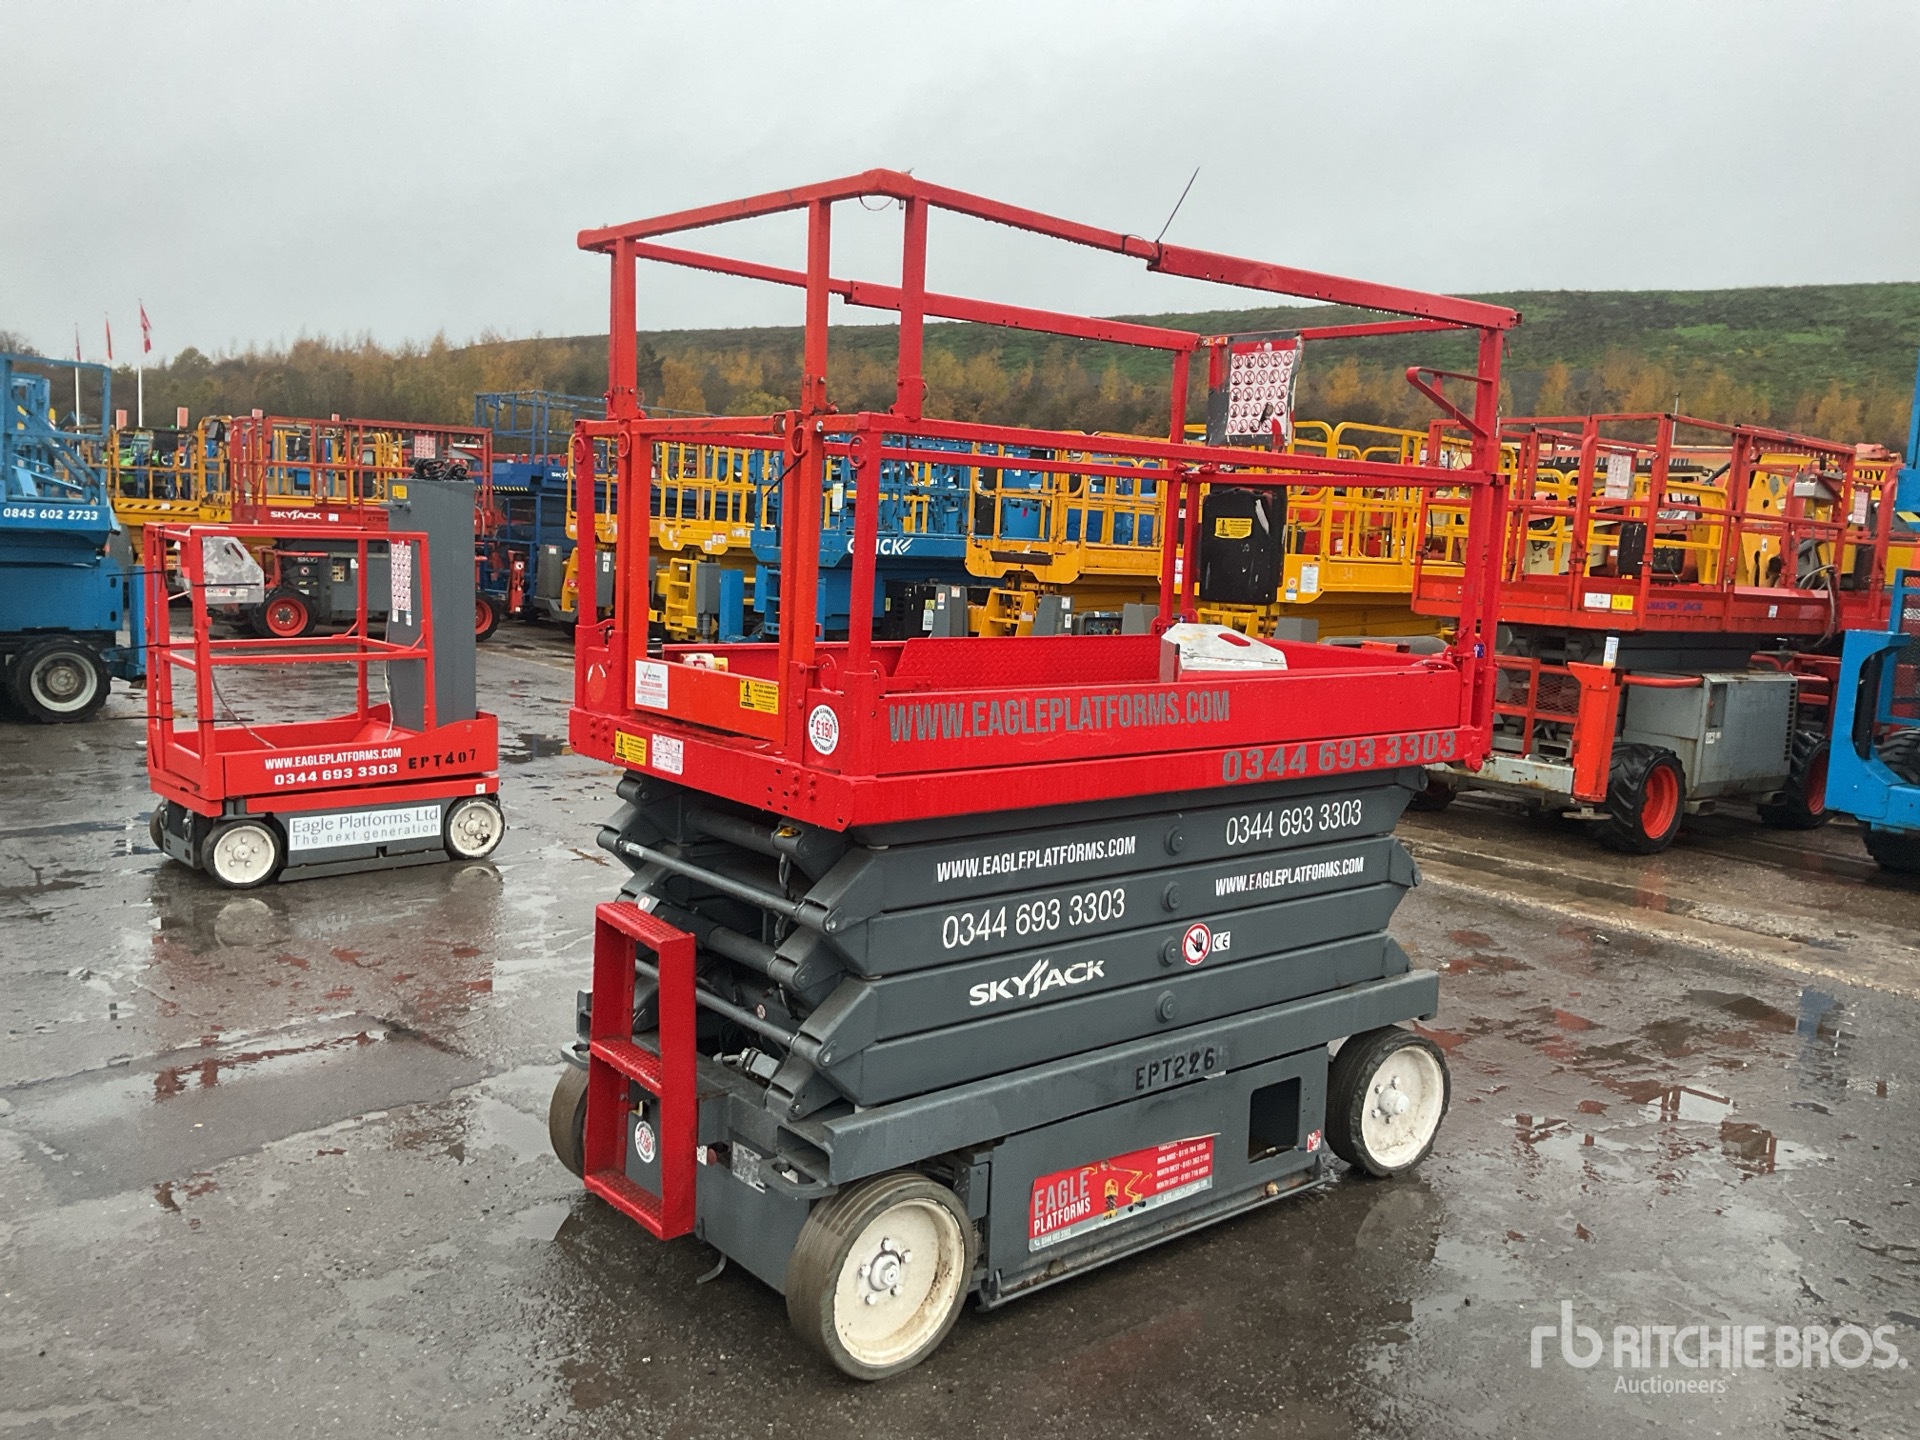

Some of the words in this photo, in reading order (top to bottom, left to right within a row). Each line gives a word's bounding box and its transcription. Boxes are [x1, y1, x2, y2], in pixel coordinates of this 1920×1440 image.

[3, 508, 35, 518] 0845
[39, 509, 63, 519] 602
[67, 510, 98, 521] 2733
[270, 509, 322, 520] SKYJACK
[847, 538, 905, 555] ICK
[889, 690, 1230, 743] WWW.EAGLEPLATFORMS.COM
[265, 747, 402, 770] WWW.EAGLEPLATFORMS.COM
[408, 748, 477, 770] EPT407
[274, 771, 317, 785] 0344
[322, 768, 353, 781] 693
[358, 763, 398, 778] 3303
[1222, 744, 1308, 783] 0344
[1317, 736, 1376, 774] 693
[1384, 730, 1457, 764] 3303
[292, 817, 334, 836] Eagle
[340, 810, 411, 830] Platforms
[416, 806, 438, 822] Ltd
[292, 834, 318, 846] The
[327, 830, 357, 843] next
[363, 822, 437, 841] generation
[1225, 811, 1273, 847] 0344
[1279, 804, 1315, 837] 693
[1318, 798, 1362, 832] 3303
[937, 835, 1136, 883] WWW.EAGLEPLATFORMS.COM
[1215, 856, 1364, 897] WWW.EAGLEPLATFORMS.COM
[942, 904, 1008, 949] 0344
[1015, 896, 1060, 935] 693
[1069, 888, 1126, 927] 3303
[1213, 932, 1230, 950] CE
[969, 958, 1104, 1007] SKYJACK
[1135, 1047, 1214, 1091] EPT226
[1034, 1170, 1089, 1219] EAGLE
[1033, 1197, 1091, 1237] PLATFORMS
